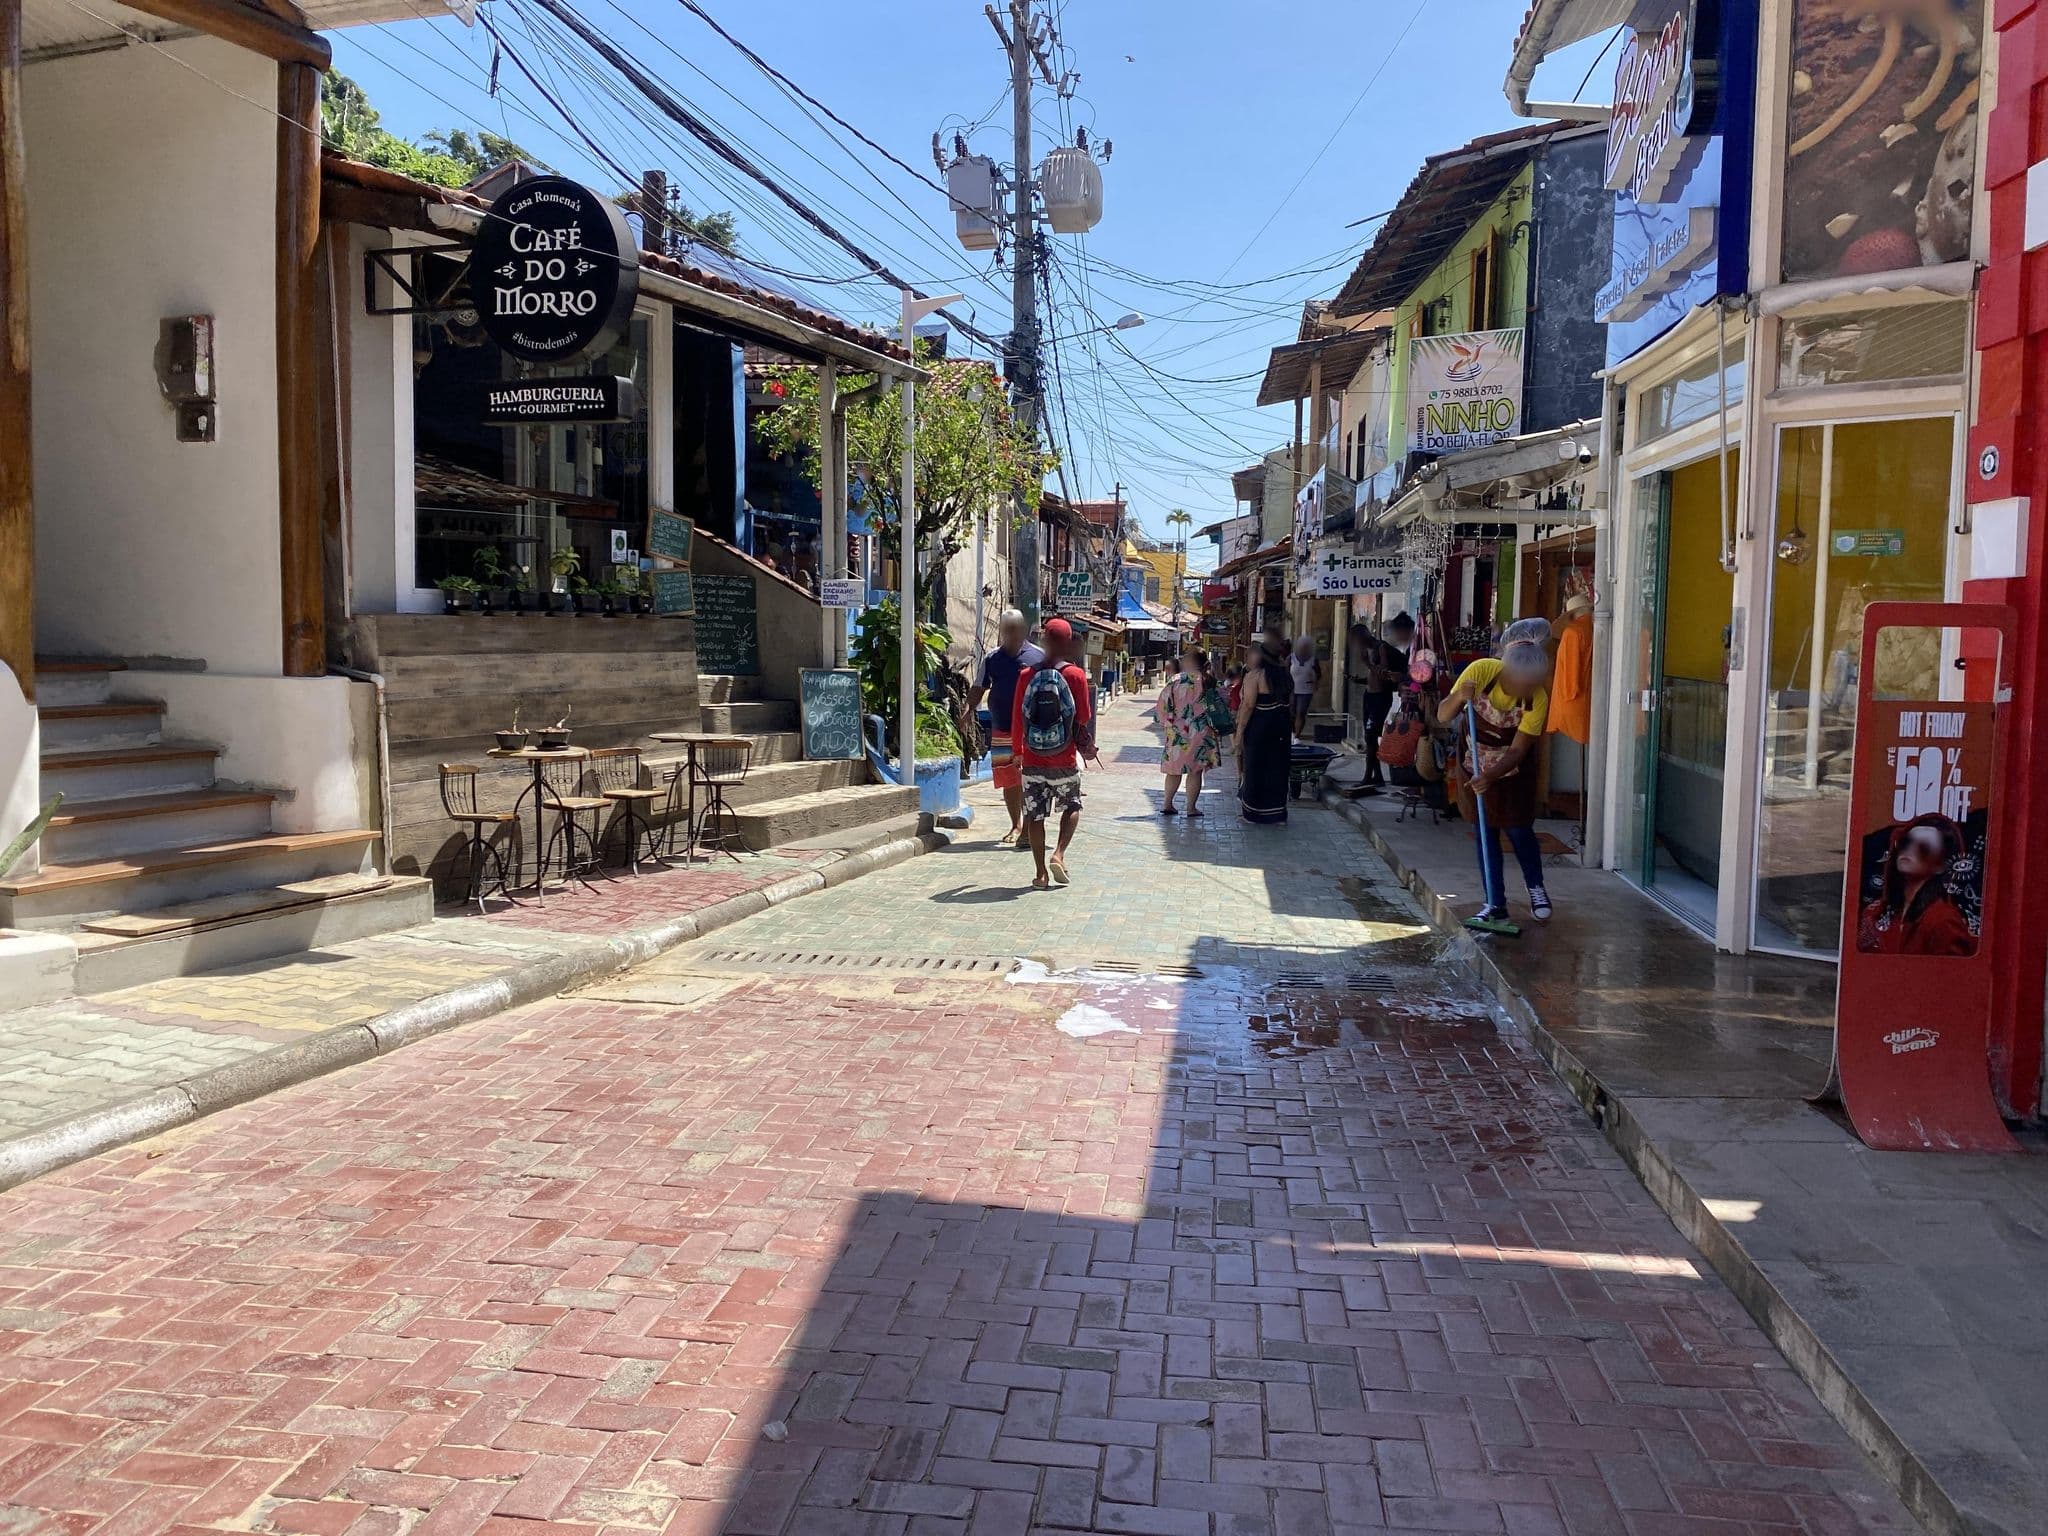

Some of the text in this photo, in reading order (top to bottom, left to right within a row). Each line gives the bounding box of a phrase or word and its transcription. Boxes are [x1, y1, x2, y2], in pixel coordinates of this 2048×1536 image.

[509, 191, 581, 215] Casa Romena's
[524, 258, 566, 281] DO
[494, 286, 597, 317] MORRO
[512, 330, 578, 350] #bistrodemais
[489, 387, 605, 405] HAMBURGUERIA
[1439, 384, 1503, 399] 75 98813 8702
[518, 403, 575, 414] GOURMET
[1426, 397, 1515, 436] NINHO
[1427, 436, 1445, 449] DO
[1322, 576, 1391, 590] São Lucas
[1899, 711, 1966, 738] HOT FRIDAY
[1892, 1039, 1937, 1055] beans
